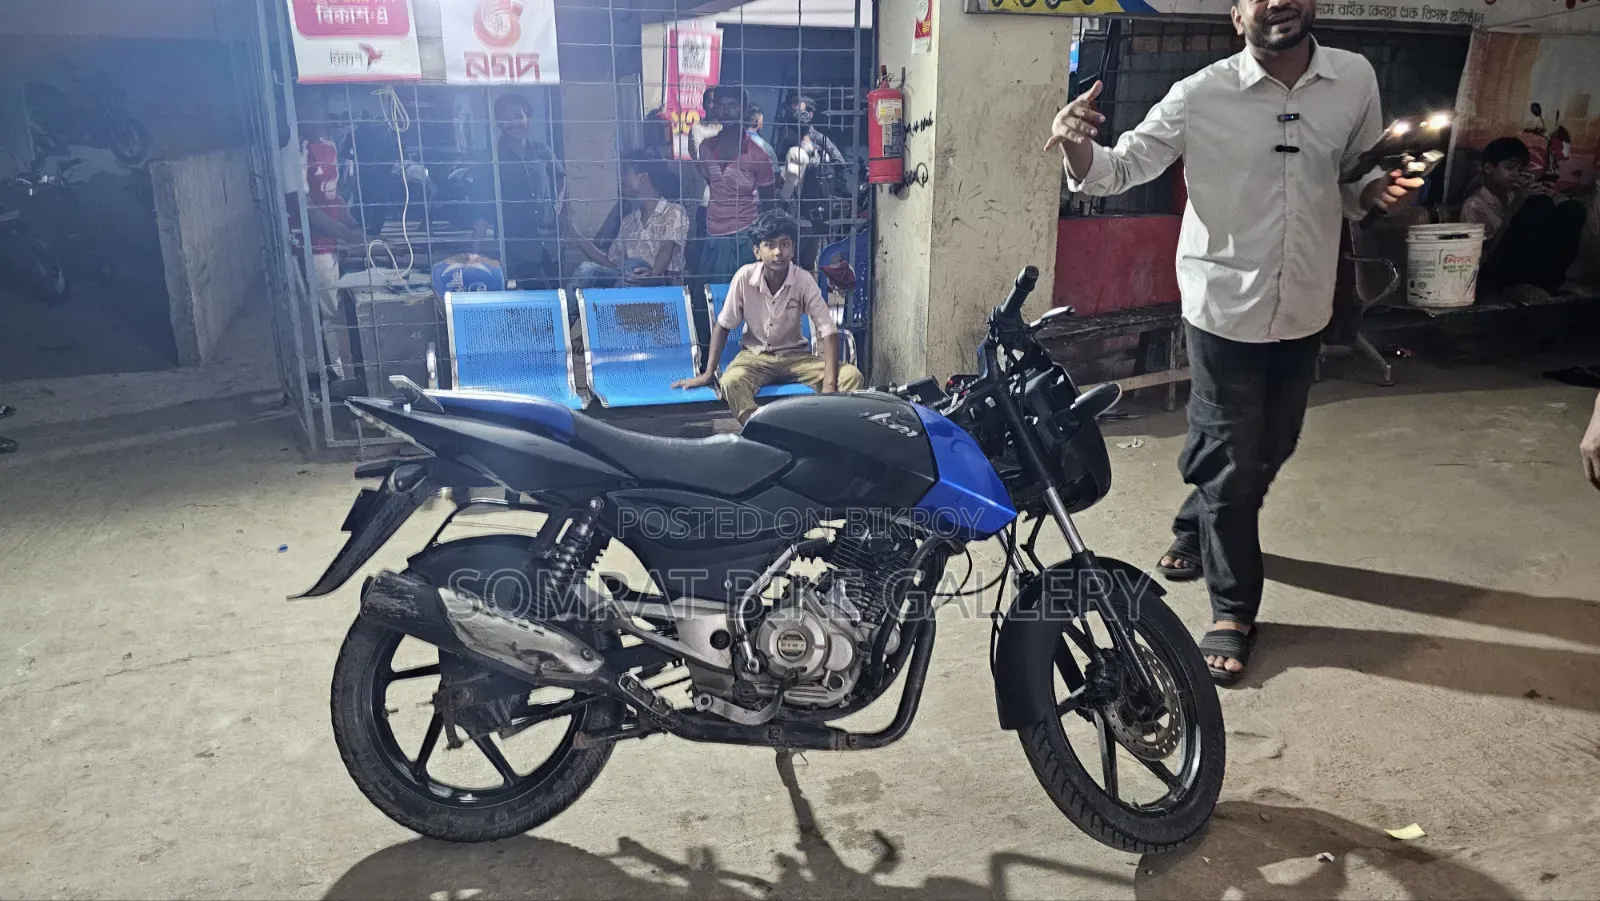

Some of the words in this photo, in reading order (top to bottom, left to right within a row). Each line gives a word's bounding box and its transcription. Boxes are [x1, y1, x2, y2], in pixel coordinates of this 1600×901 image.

[1338, 1, 1365, 16] বাইক
[1368, 5, 1397, 19] কেনার
[1400, 6, 1419, 19] এক
[463, 51, 541, 80] নগদ
